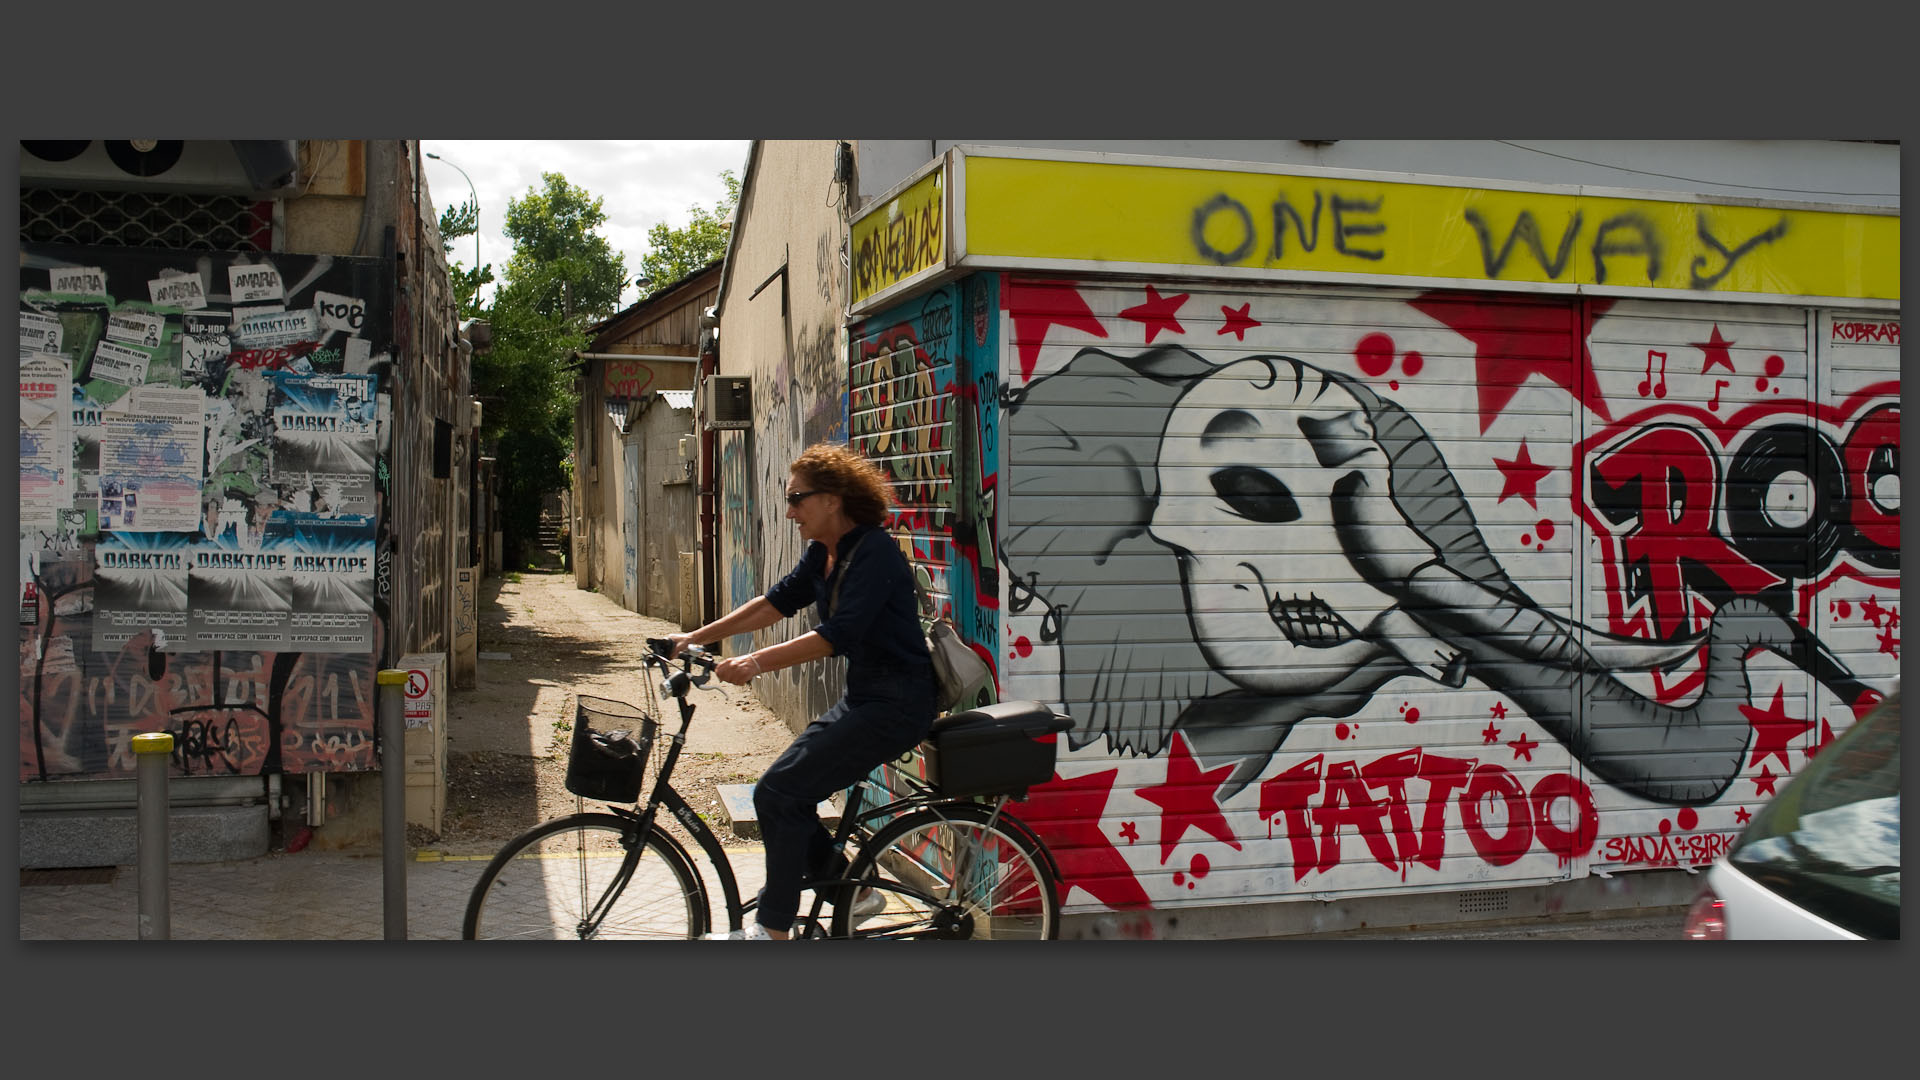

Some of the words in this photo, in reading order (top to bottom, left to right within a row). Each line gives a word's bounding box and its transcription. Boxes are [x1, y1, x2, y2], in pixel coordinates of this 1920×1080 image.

[1190, 191, 1388, 265] ONE
[1464, 208, 1791, 290] WAY
[57, 274, 104, 291] AMARA
[235, 271, 280, 288] AMARA
[157, 280, 202, 301] AMARA
[189, 323, 226, 334] HIP-HOP
[242, 316, 308, 335] DARKTAPE
[197, 552, 287, 570] DARKTAPE
[1258, 747, 1600, 882] TATTOO
